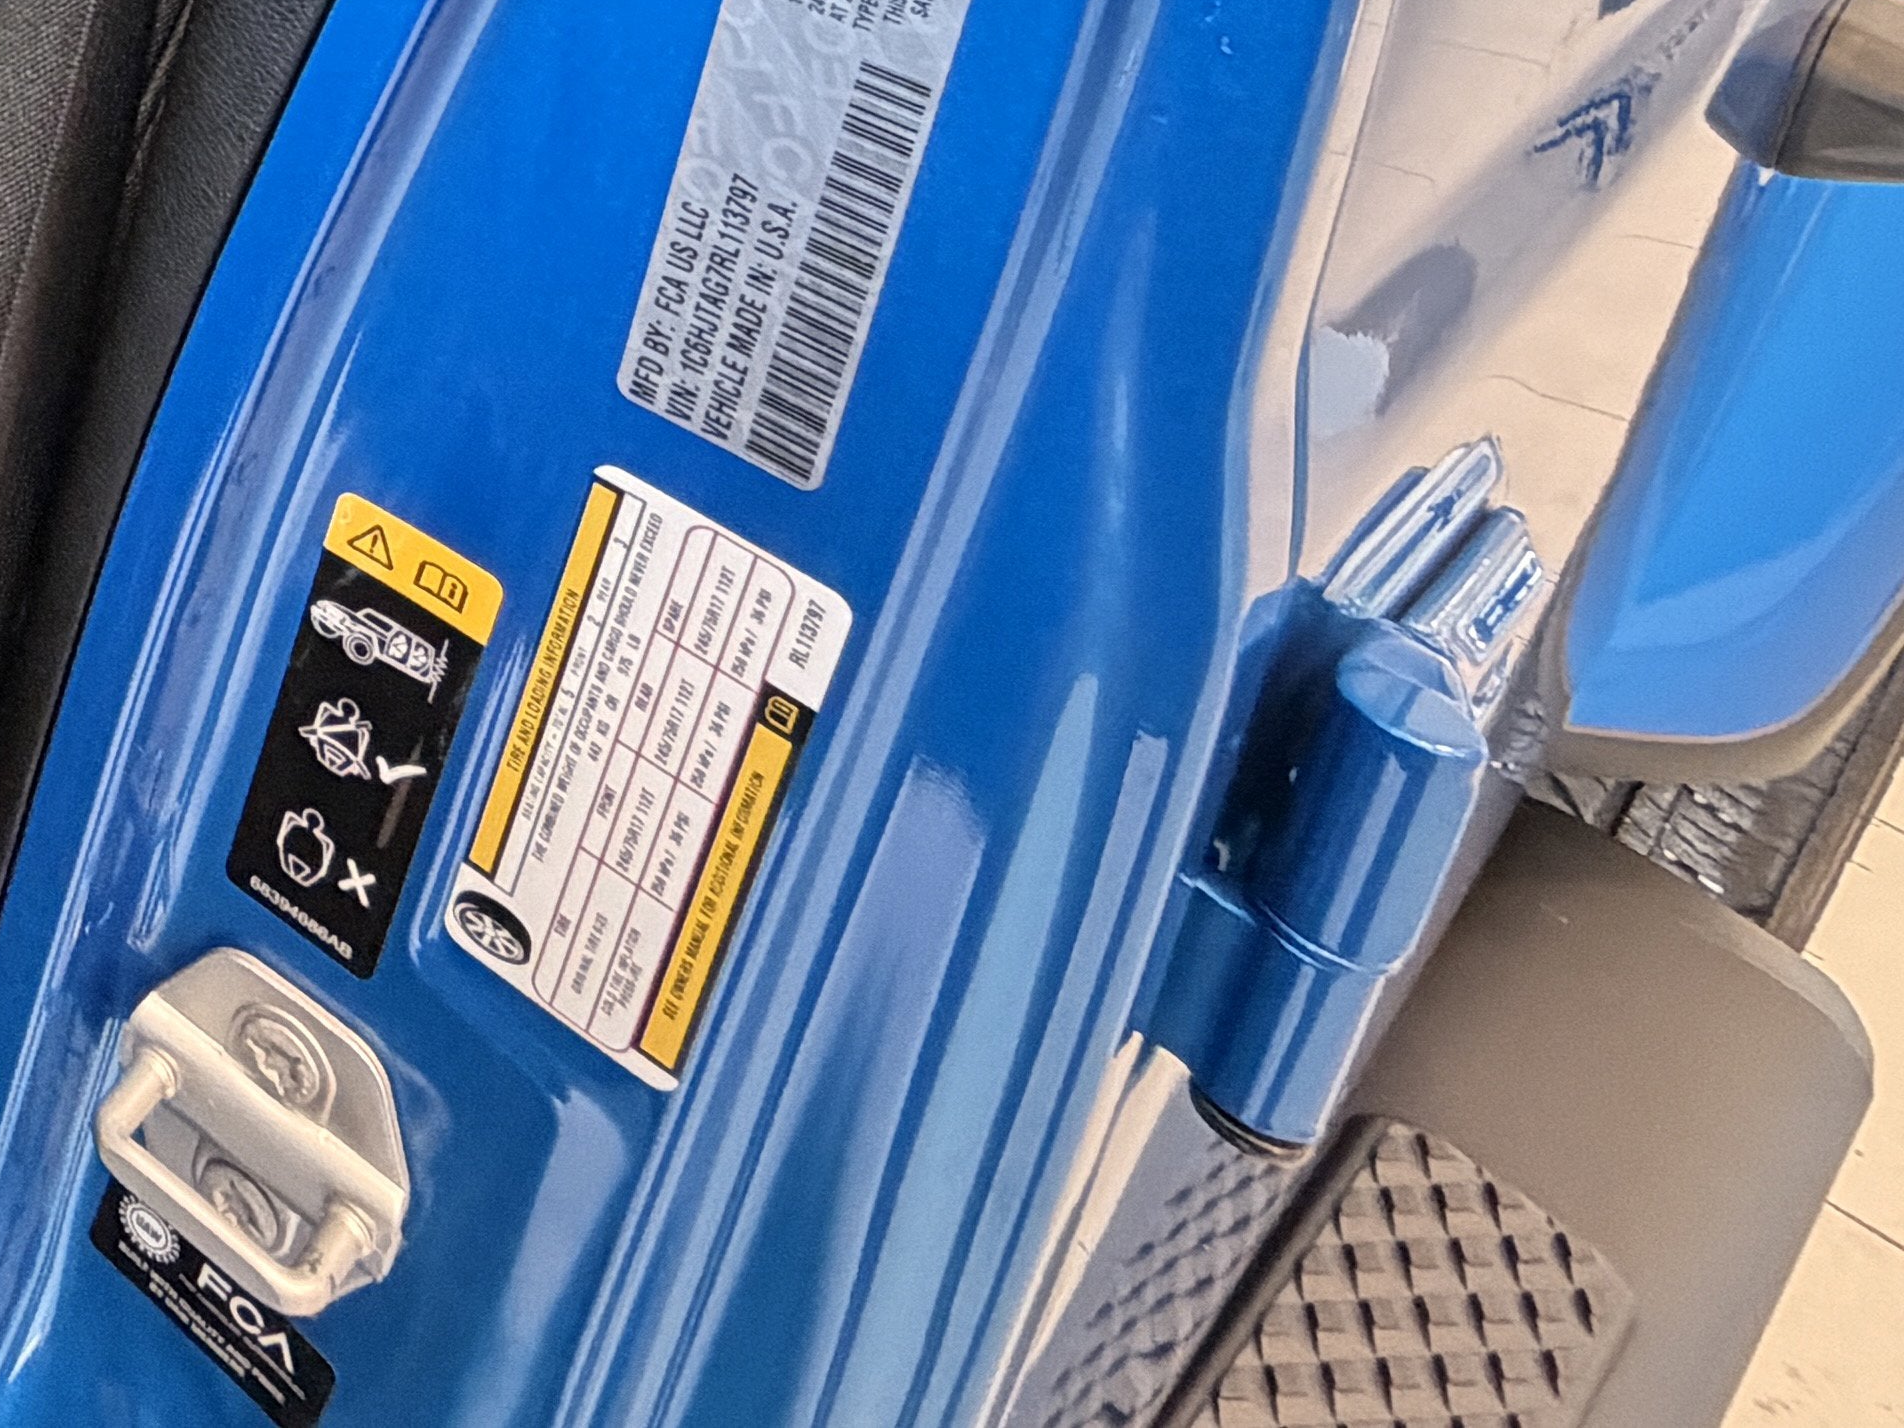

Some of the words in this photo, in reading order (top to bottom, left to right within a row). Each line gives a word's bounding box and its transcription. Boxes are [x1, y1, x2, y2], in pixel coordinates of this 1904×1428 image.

[828, 2, 850, 25] AT
[673, 198, 709, 243] LLC
[752, 190, 798, 262] U.S.A.
[664, 237, 698, 275] US
[742, 256, 778, 297] IN:
[652, 270, 689, 318] FCA
[641, 314, 676, 358] BY:
[724, 291, 768, 359] MADE
[628, 352, 665, 407] MFD
[664, 373, 701, 425] VIN:
[699, 353, 750, 445] VEHICLE
[541, 586, 579, 669] INFORMATION
[786, 597, 828, 670] RL113797
[524, 666, 552, 720] LOADING
[515, 716, 535, 746] AND
[505, 742, 525, 774] TIRE
[196, 1262, 295, 1377] FCA
